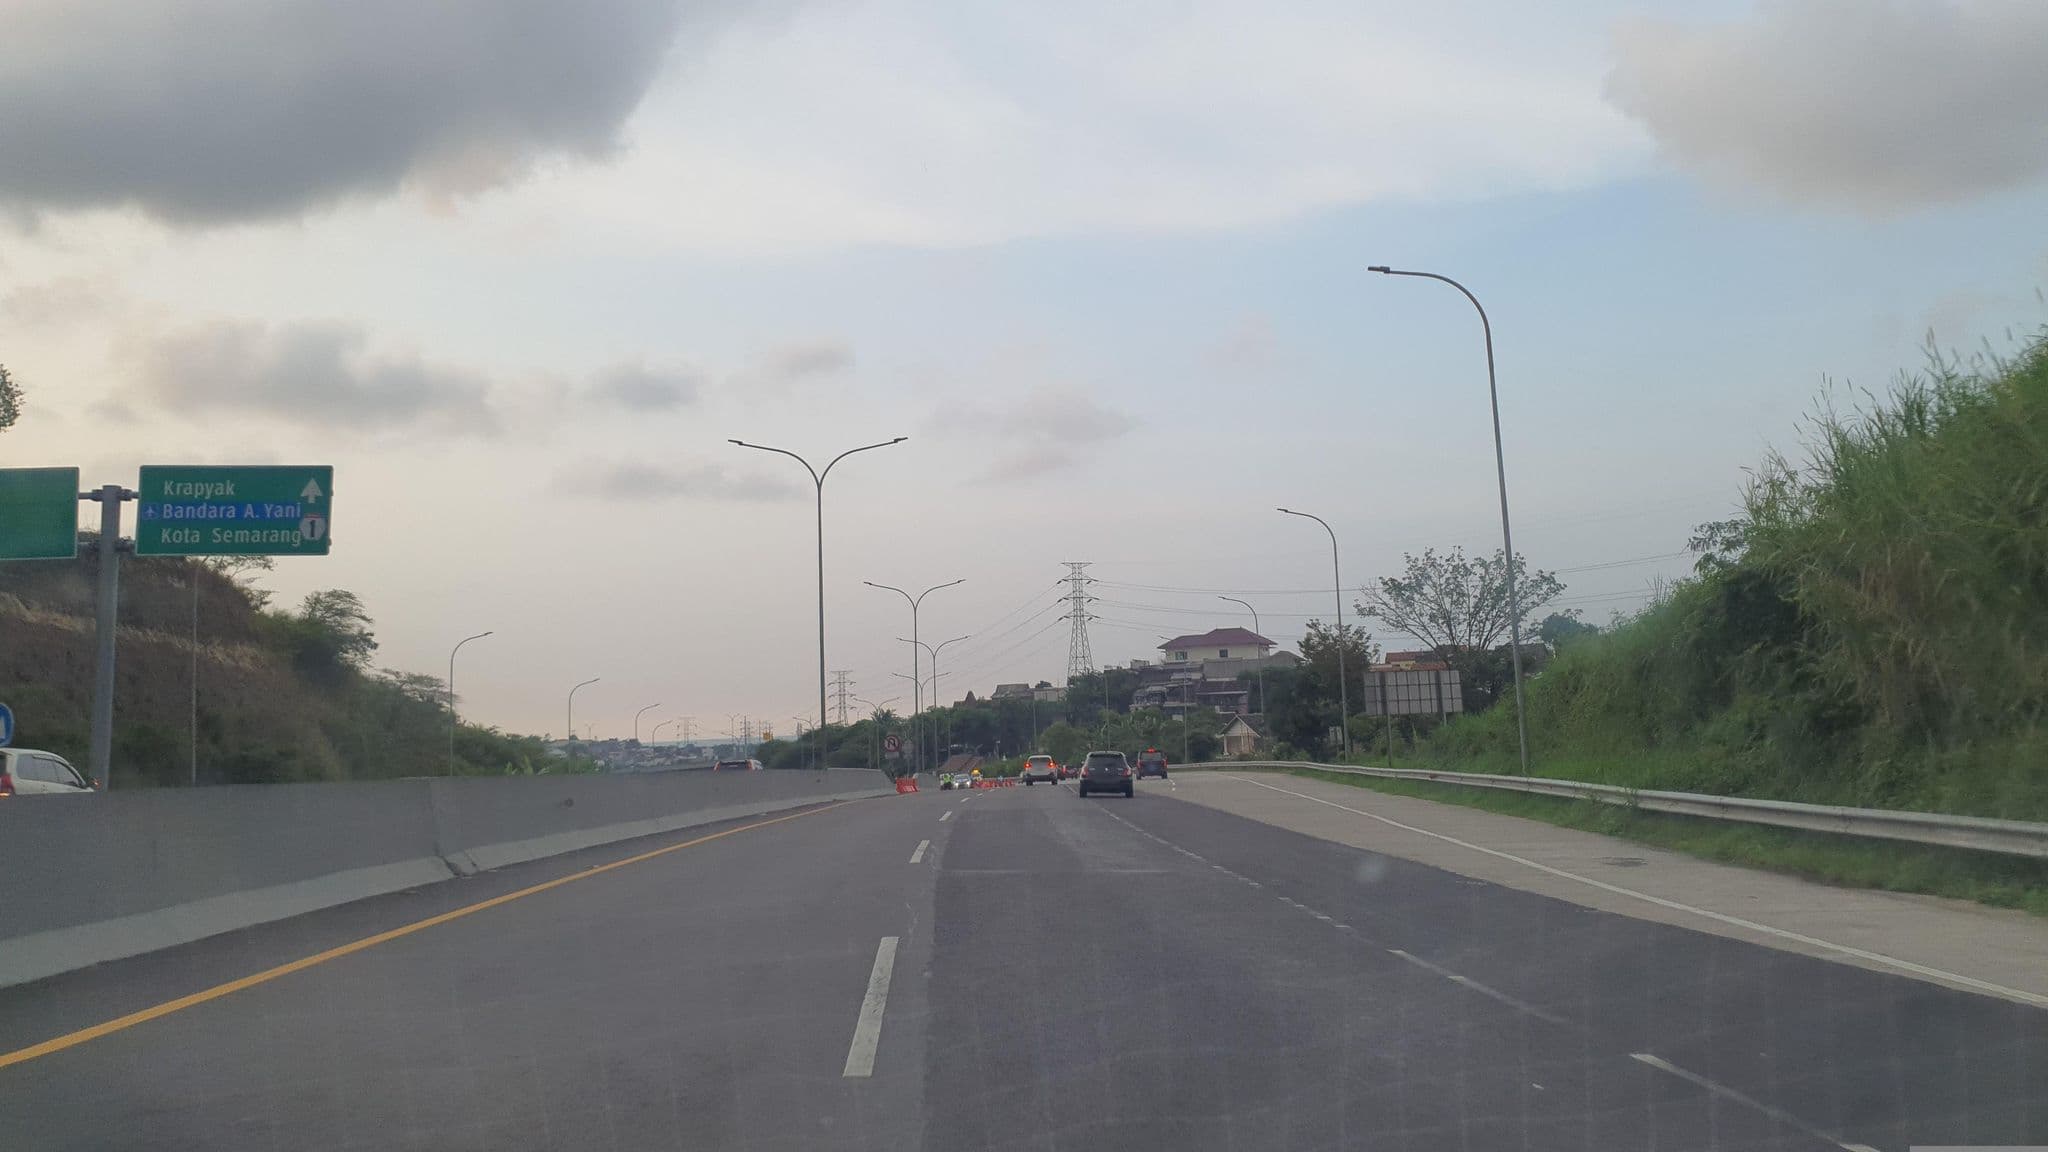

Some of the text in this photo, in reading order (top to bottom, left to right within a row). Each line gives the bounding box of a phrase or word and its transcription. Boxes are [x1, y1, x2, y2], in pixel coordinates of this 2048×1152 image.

[163, 480, 235, 499] Krapyak
[162, 502, 301, 519] Bandara A. Yani
[161, 527, 302, 547] Kota Semarang
